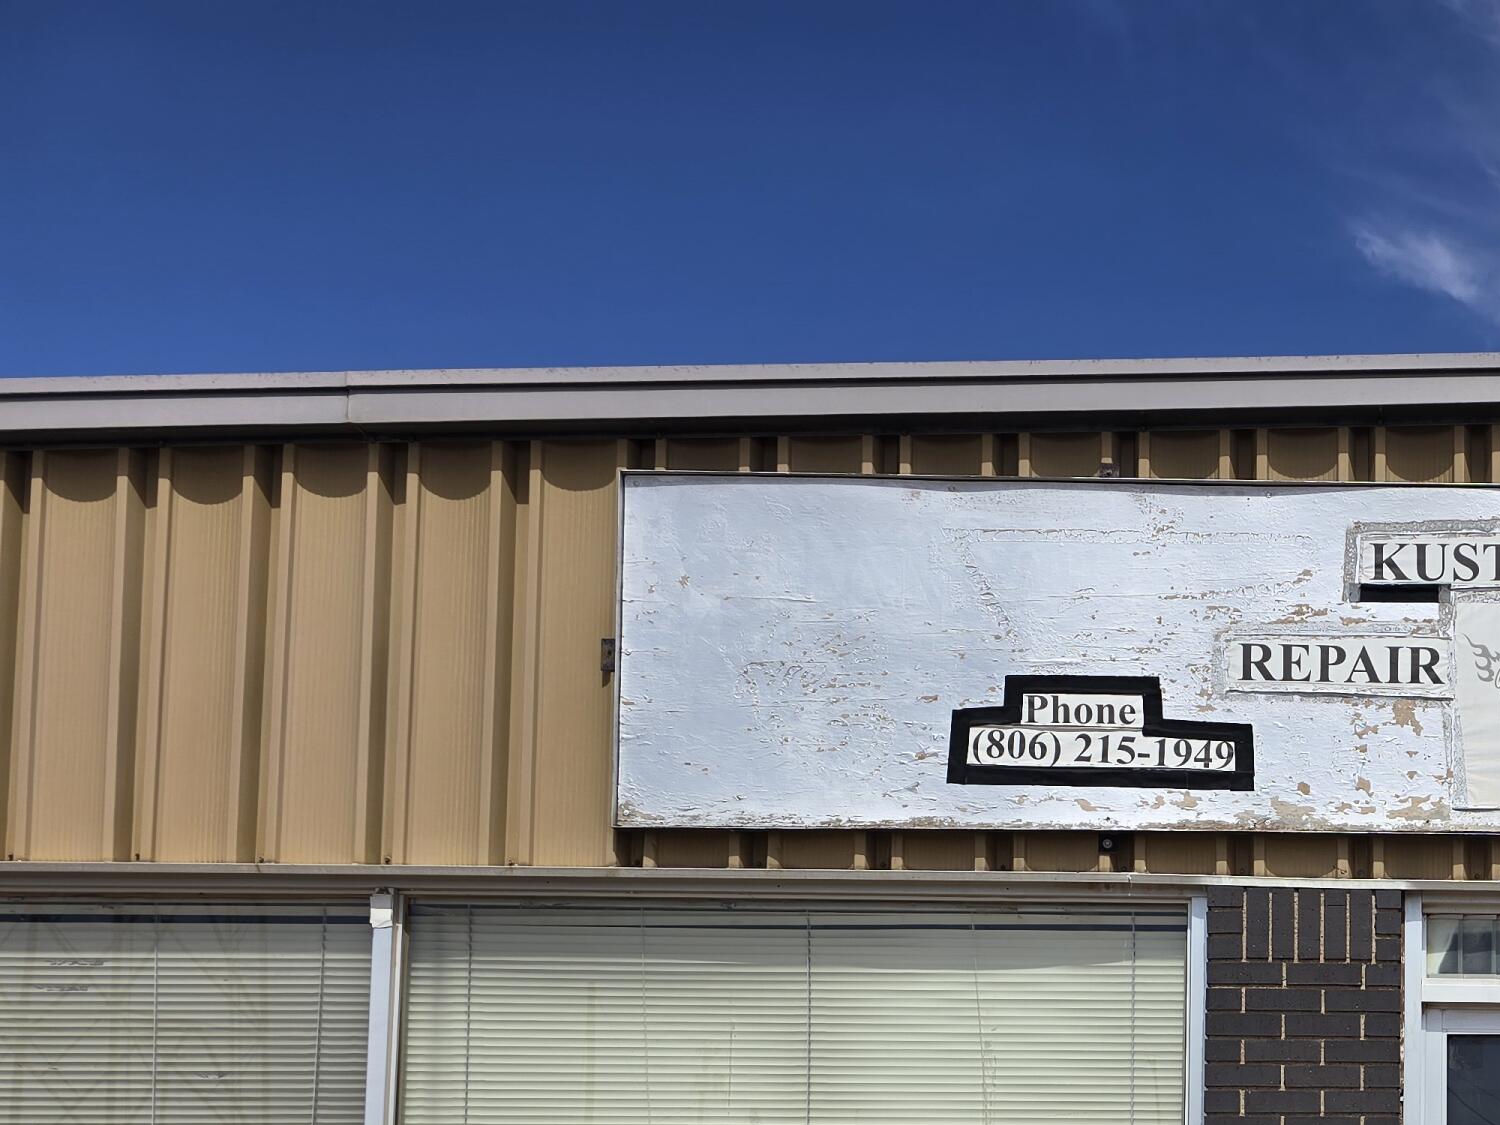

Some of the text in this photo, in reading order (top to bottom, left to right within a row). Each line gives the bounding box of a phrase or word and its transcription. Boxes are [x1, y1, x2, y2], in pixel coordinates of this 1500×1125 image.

[1238, 642, 1445, 686] REPAIR
[1023, 694, 1136, 725] Phone
[972, 729, 1235, 770] (806) 215-1949
